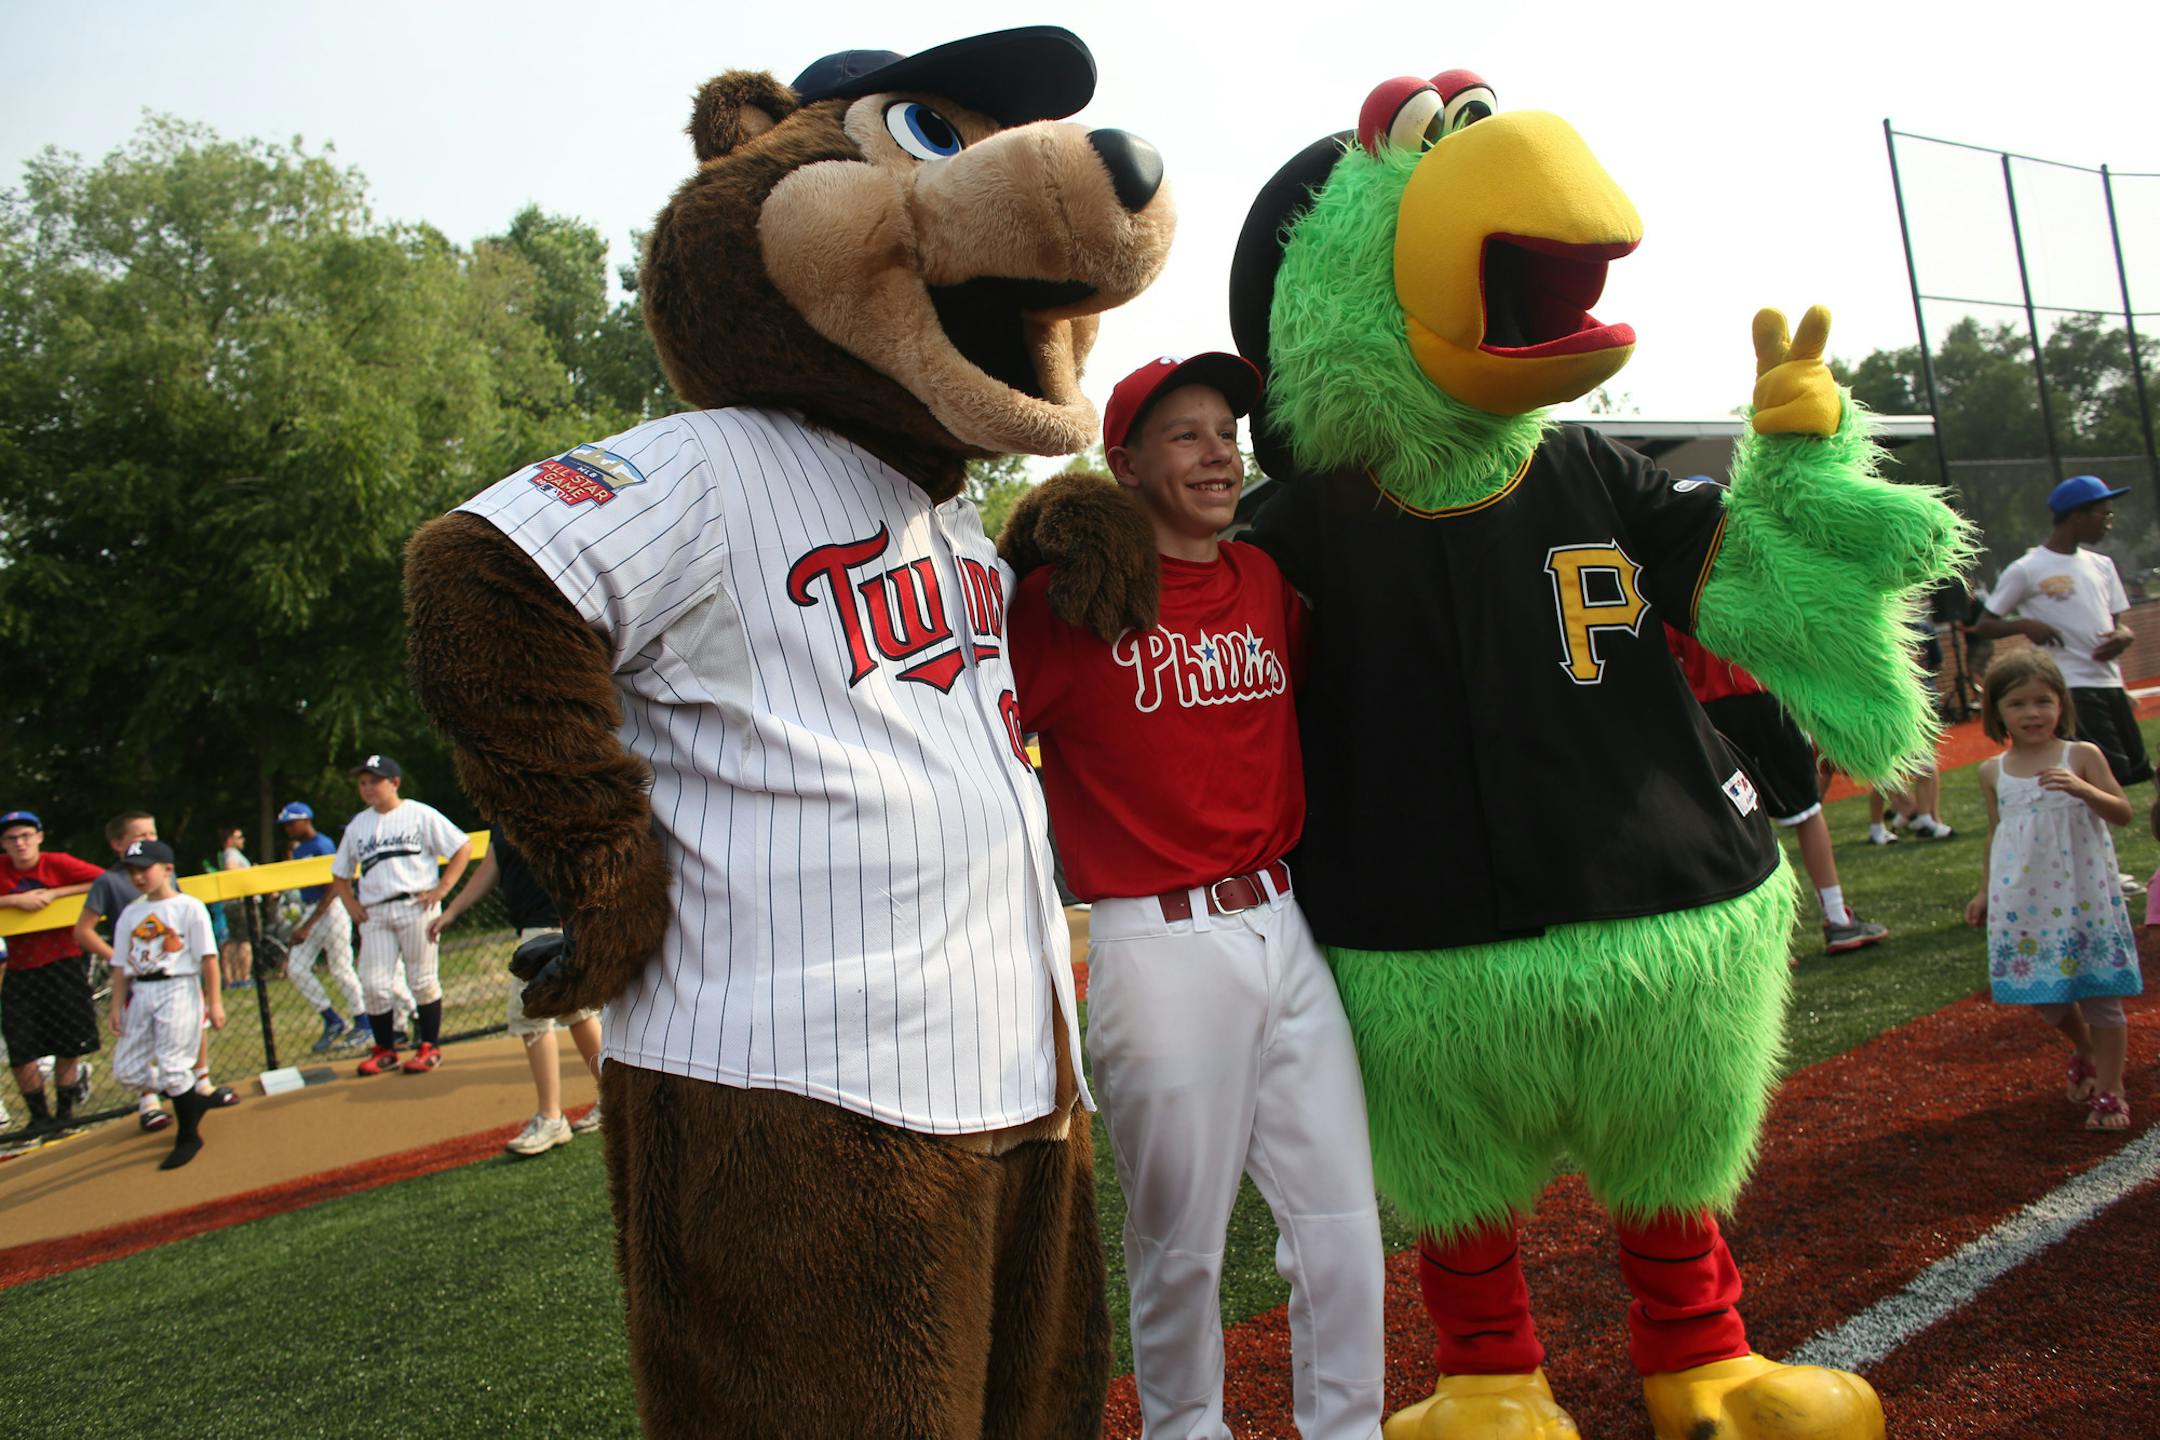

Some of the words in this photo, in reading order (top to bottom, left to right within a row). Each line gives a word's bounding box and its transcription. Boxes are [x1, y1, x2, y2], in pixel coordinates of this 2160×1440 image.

[543, 472, 584, 498] GAME
[544, 463, 570, 477] ALL
[571, 474, 609, 501] STAR
[1543, 538, 1652, 686] P
[1112, 622, 1286, 713] Phillies
[366, 754, 381, 768] R
